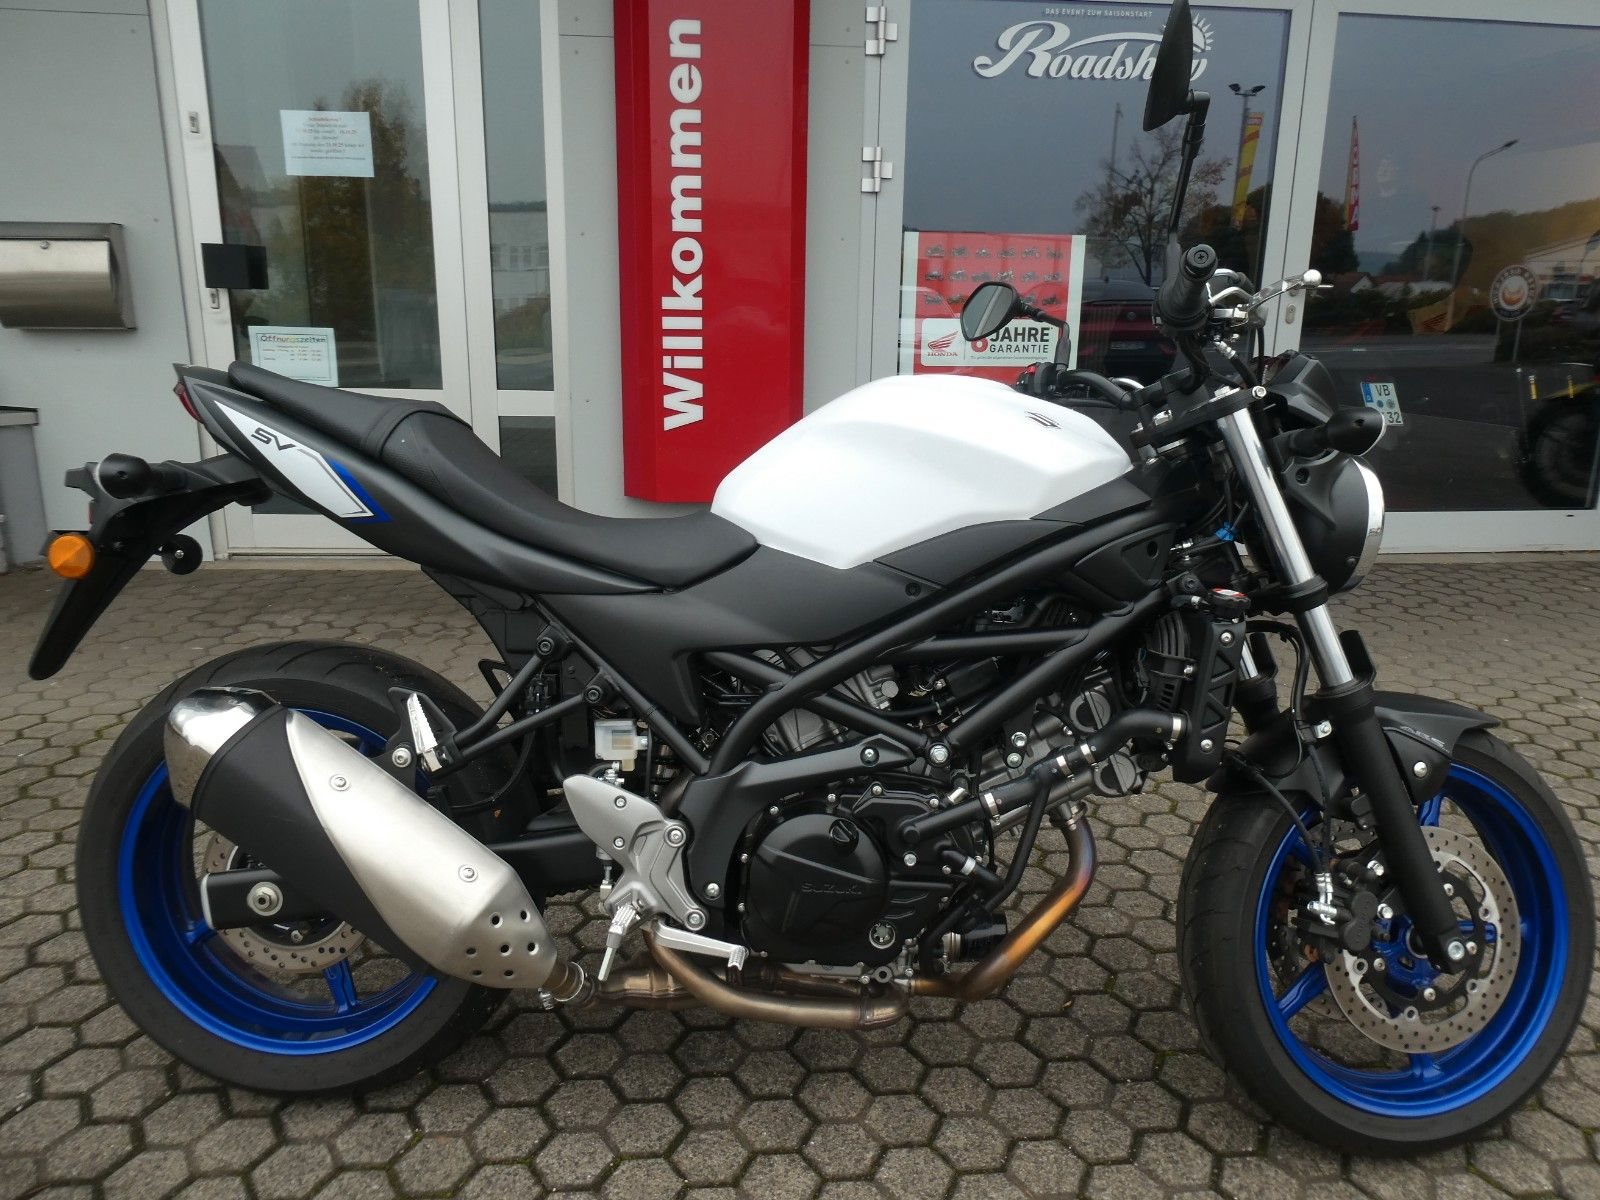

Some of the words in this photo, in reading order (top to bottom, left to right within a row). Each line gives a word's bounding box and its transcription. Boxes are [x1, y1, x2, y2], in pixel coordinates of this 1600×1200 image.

[1104, 9, 1153, 17] SAISONSTART
[974, 20, 1208, 81] Roadshw
[661, 18, 704, 431] Willkommen
[990, 326, 1050, 342] JAHRE
[989, 344, 1049, 353] GARANTIE
[1375, 384, 1391, 397] VB
[250, 427, 297, 452] SV
